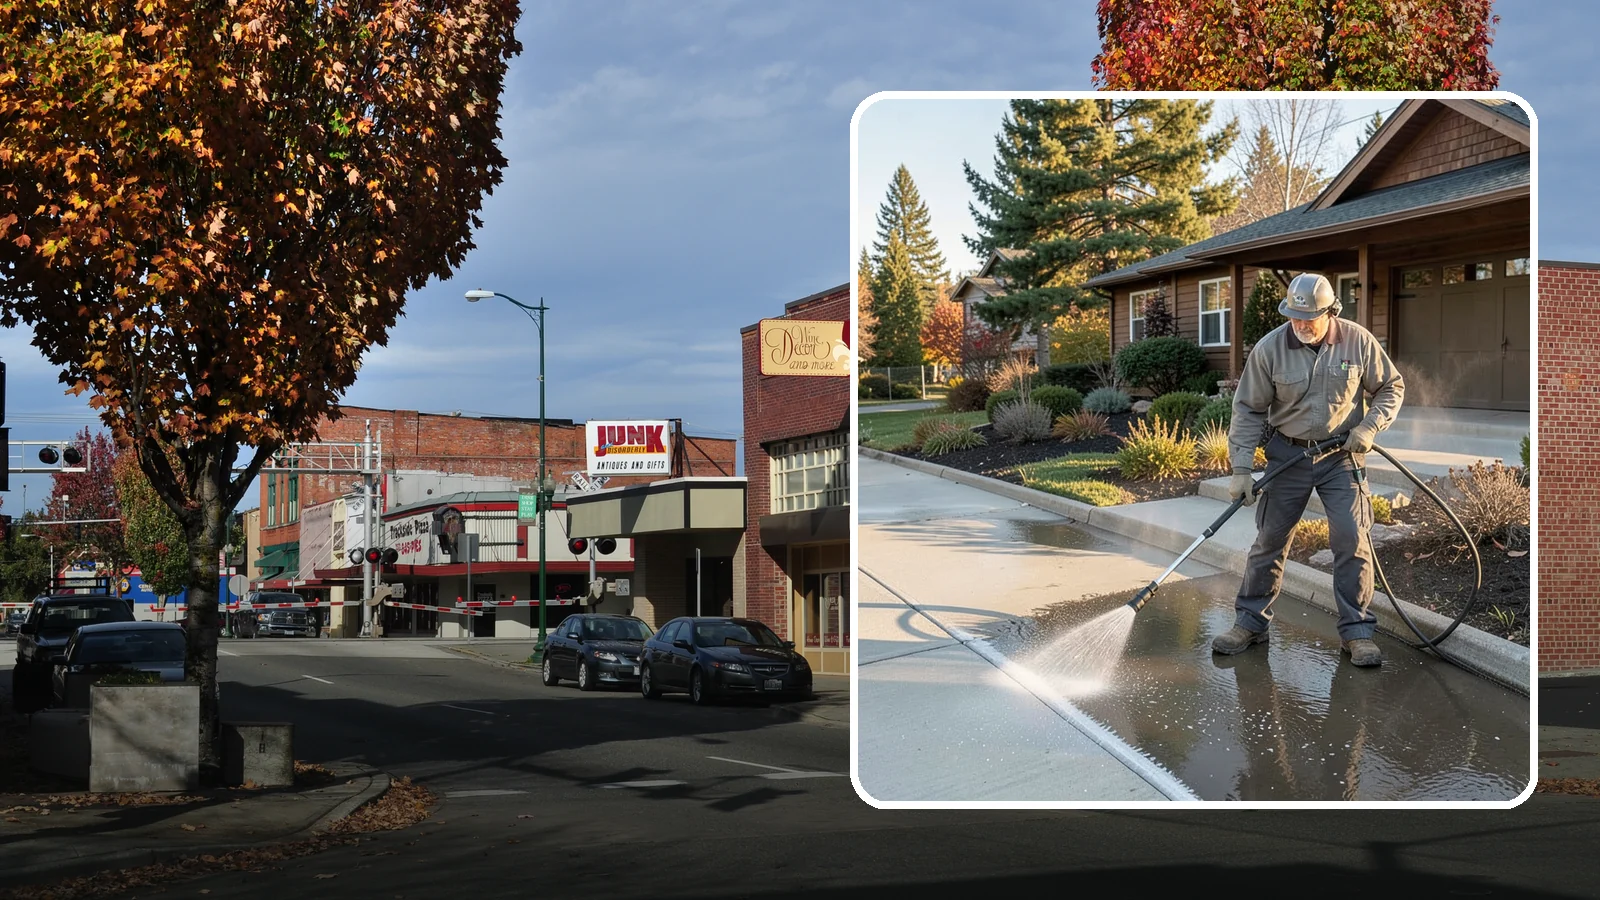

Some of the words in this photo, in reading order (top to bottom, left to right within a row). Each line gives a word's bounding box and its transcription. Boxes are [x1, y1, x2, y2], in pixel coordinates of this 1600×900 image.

[595, 425, 665, 457] JUNK
[597, 461, 628, 470] ANTIQUES
[631, 461, 644, 470] AND
[646, 460, 665, 470] GIFTS
[352, 498, 365, 511] CRO
[390, 521, 413, 540] Trackside
[414, 519, 429, 535] Pizza
